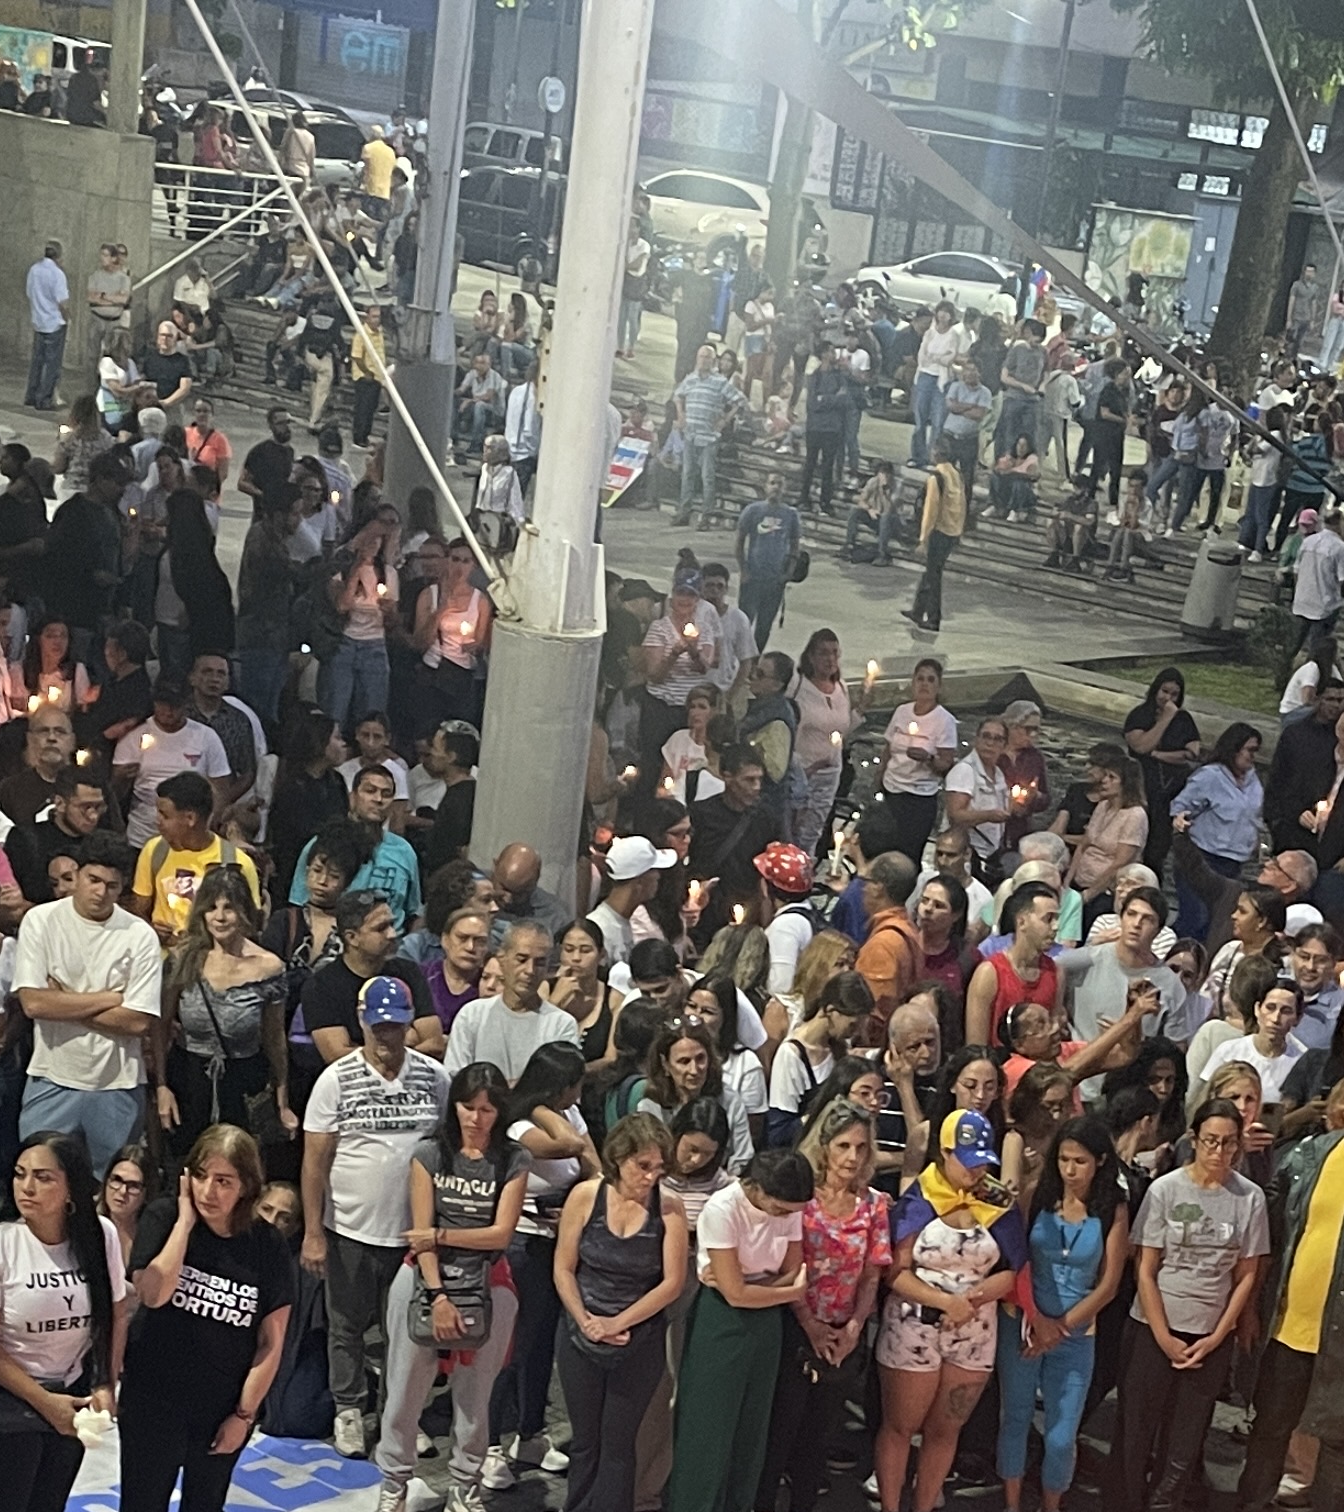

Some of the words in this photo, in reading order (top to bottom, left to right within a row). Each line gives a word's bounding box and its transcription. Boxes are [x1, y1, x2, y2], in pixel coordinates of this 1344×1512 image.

[25, 1267, 87, 1290] JUSTIC
[230, 1277, 258, 1298] LOS
[61, 1293, 76, 1311] Y
[176, 1279, 238, 1307] ENTROS
[237, 1296, 259, 1315] DE
[171, 1291, 253, 1330] ORTURA
[25, 1311, 93, 1334] LIBERT
